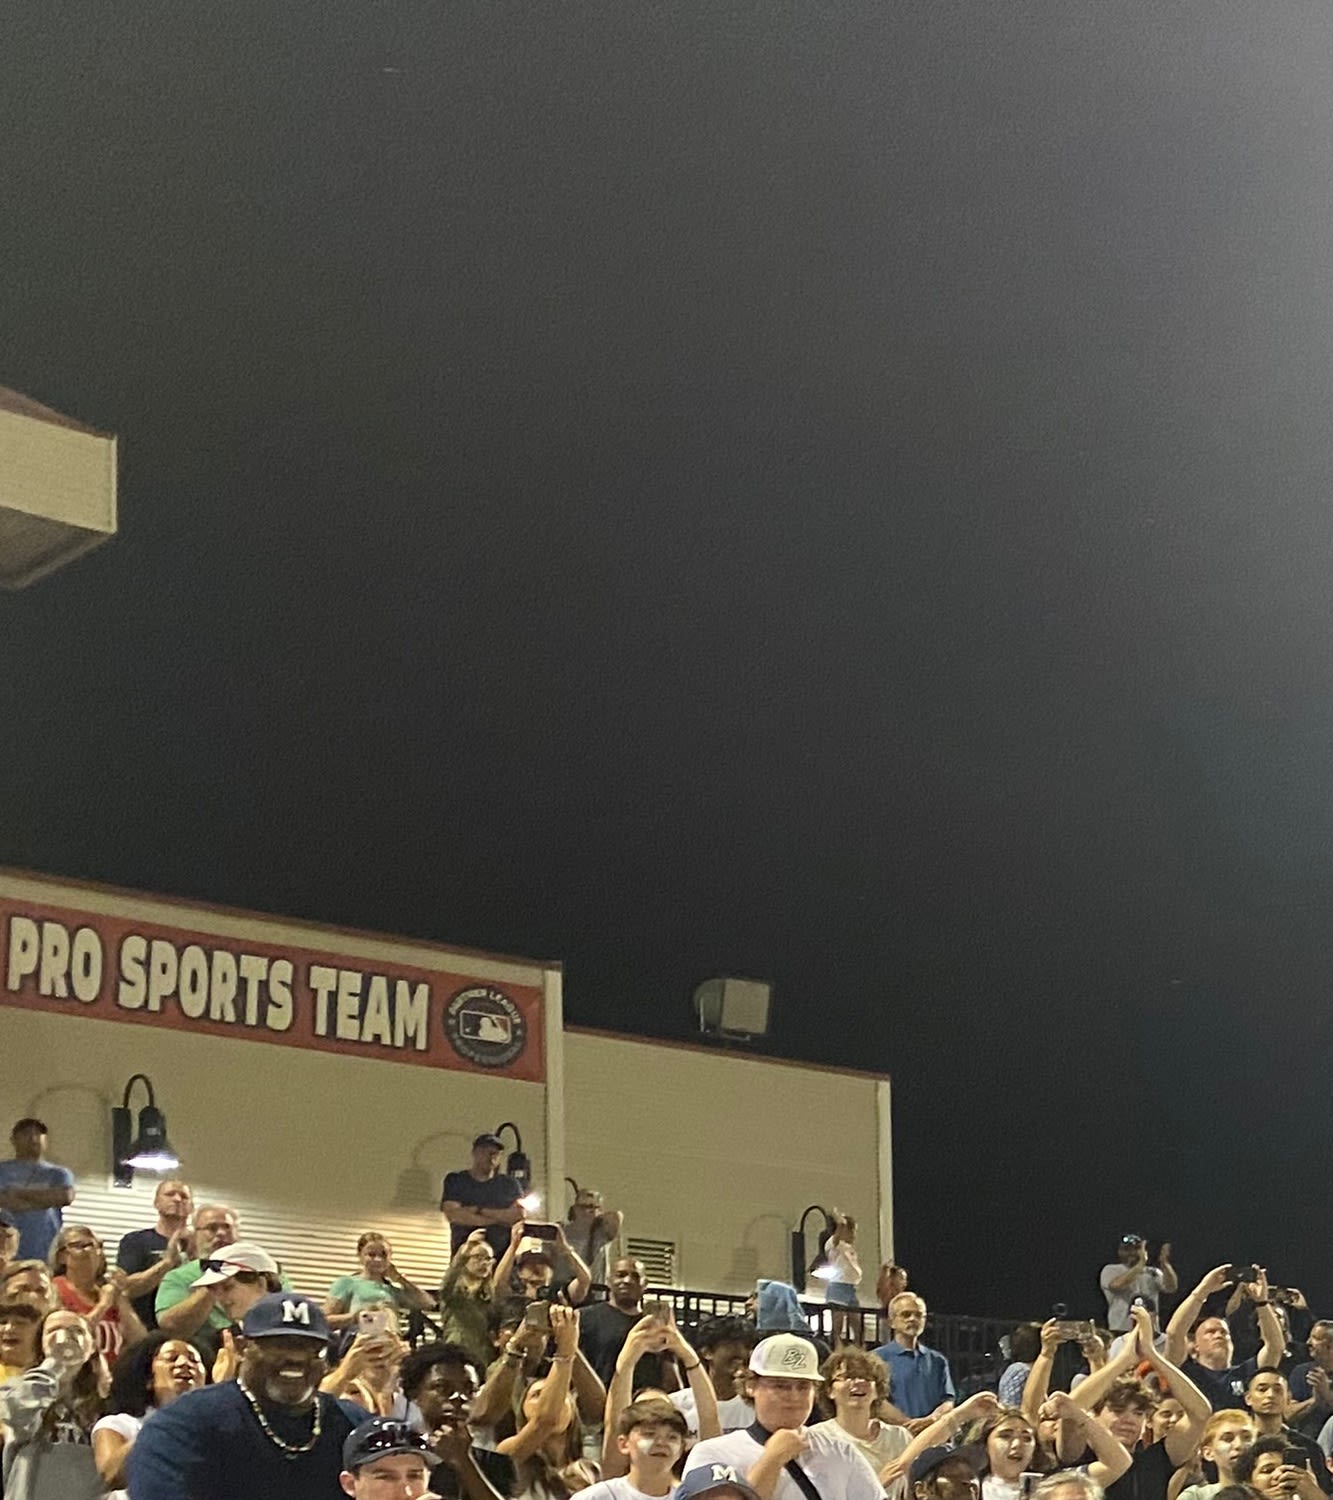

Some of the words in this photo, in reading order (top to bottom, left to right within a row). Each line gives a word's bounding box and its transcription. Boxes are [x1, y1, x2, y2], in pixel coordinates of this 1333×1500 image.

[6, 916, 103, 1002] PRO
[117, 935, 294, 1031] SPORTS
[309, 965, 430, 1050] TEAM
[282, 1299, 311, 1325] M
[711, 1464, 739, 1484] M
